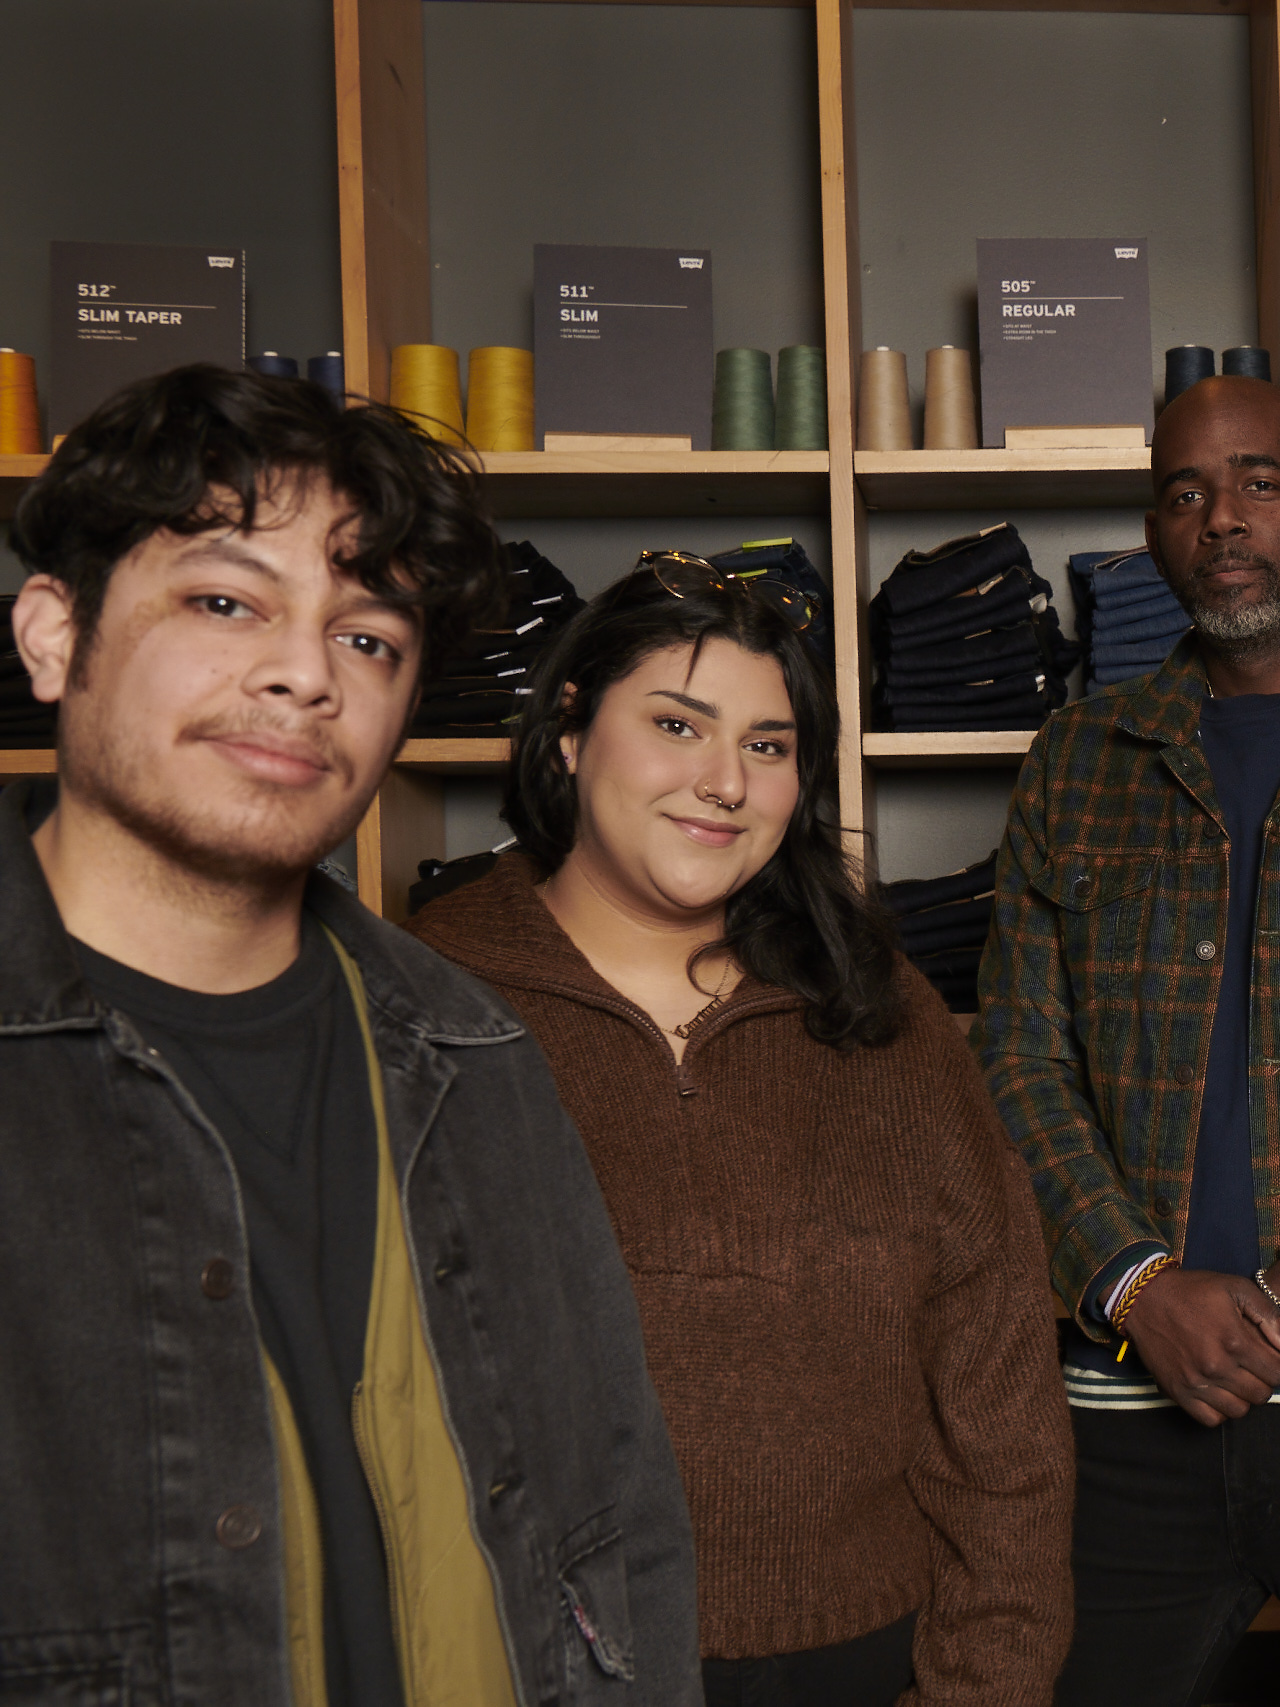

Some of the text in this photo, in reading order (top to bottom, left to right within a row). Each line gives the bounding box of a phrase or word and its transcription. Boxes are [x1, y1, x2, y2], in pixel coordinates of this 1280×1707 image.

[79, 309, 182, 325] SLIM TAPER
[560, 308, 598, 322] SLIM
[1002, 304, 1076, 317] REGULAR
